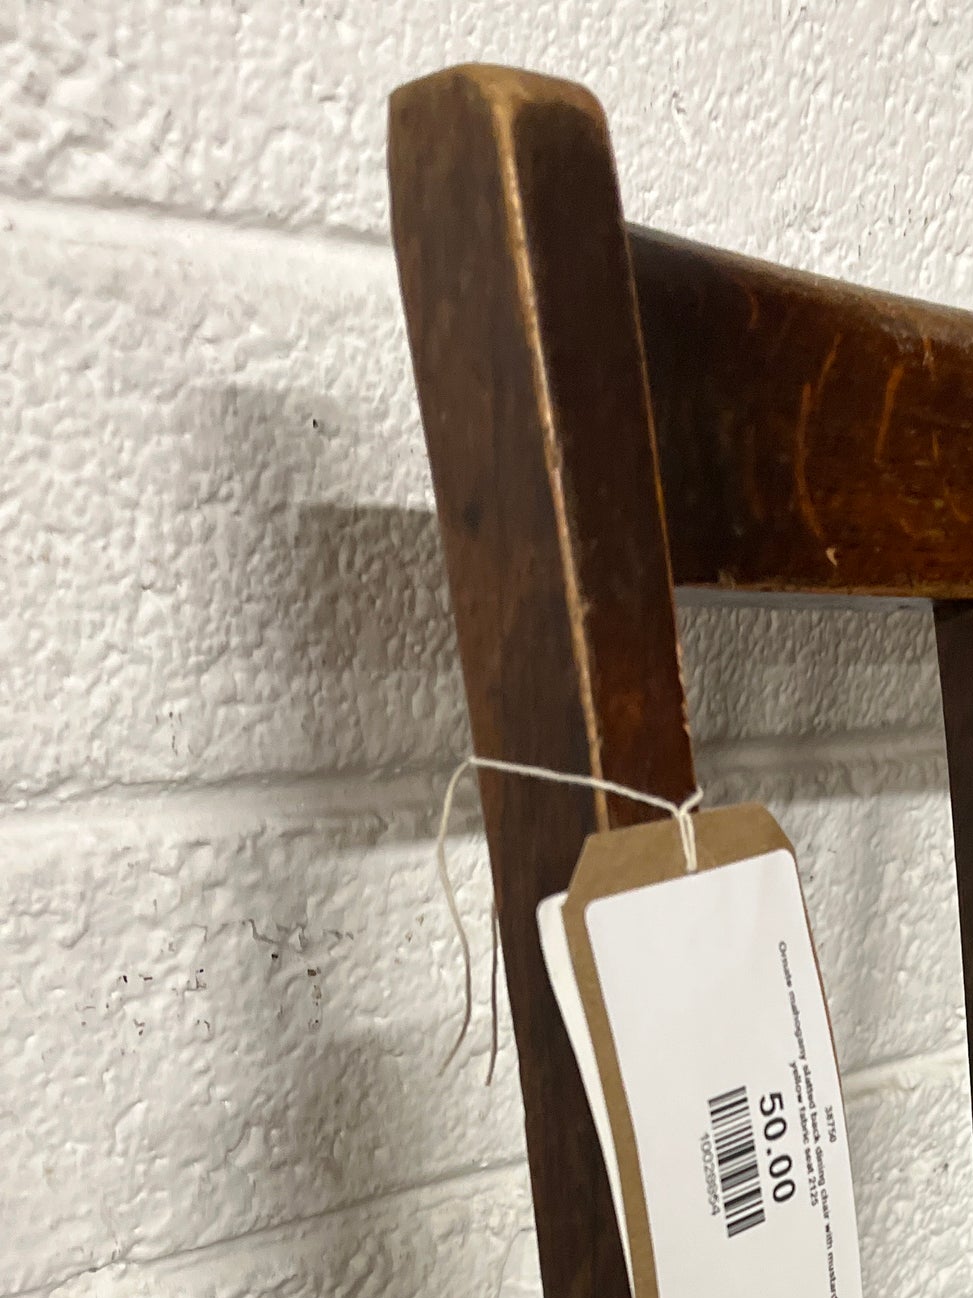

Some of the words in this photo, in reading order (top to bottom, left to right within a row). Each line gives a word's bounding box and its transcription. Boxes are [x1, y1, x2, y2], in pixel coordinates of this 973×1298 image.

[779, 941, 792, 987] Ornate
[789, 991, 806, 1060] mahogany
[789, 1062, 802, 1103] yellow
[803, 1064, 816, 1109] slatted
[799, 1106, 810, 1144] fabric
[811, 1112, 821, 1144] back
[759, 1092, 796, 1203] 50.00
[804, 1148, 814, 1174] seat
[815, 1146, 826, 1186] dining
[808, 1176, 819, 1206] 2125
[820, 1188, 829, 1219] chair
[825, 1224, 833, 1249] with
